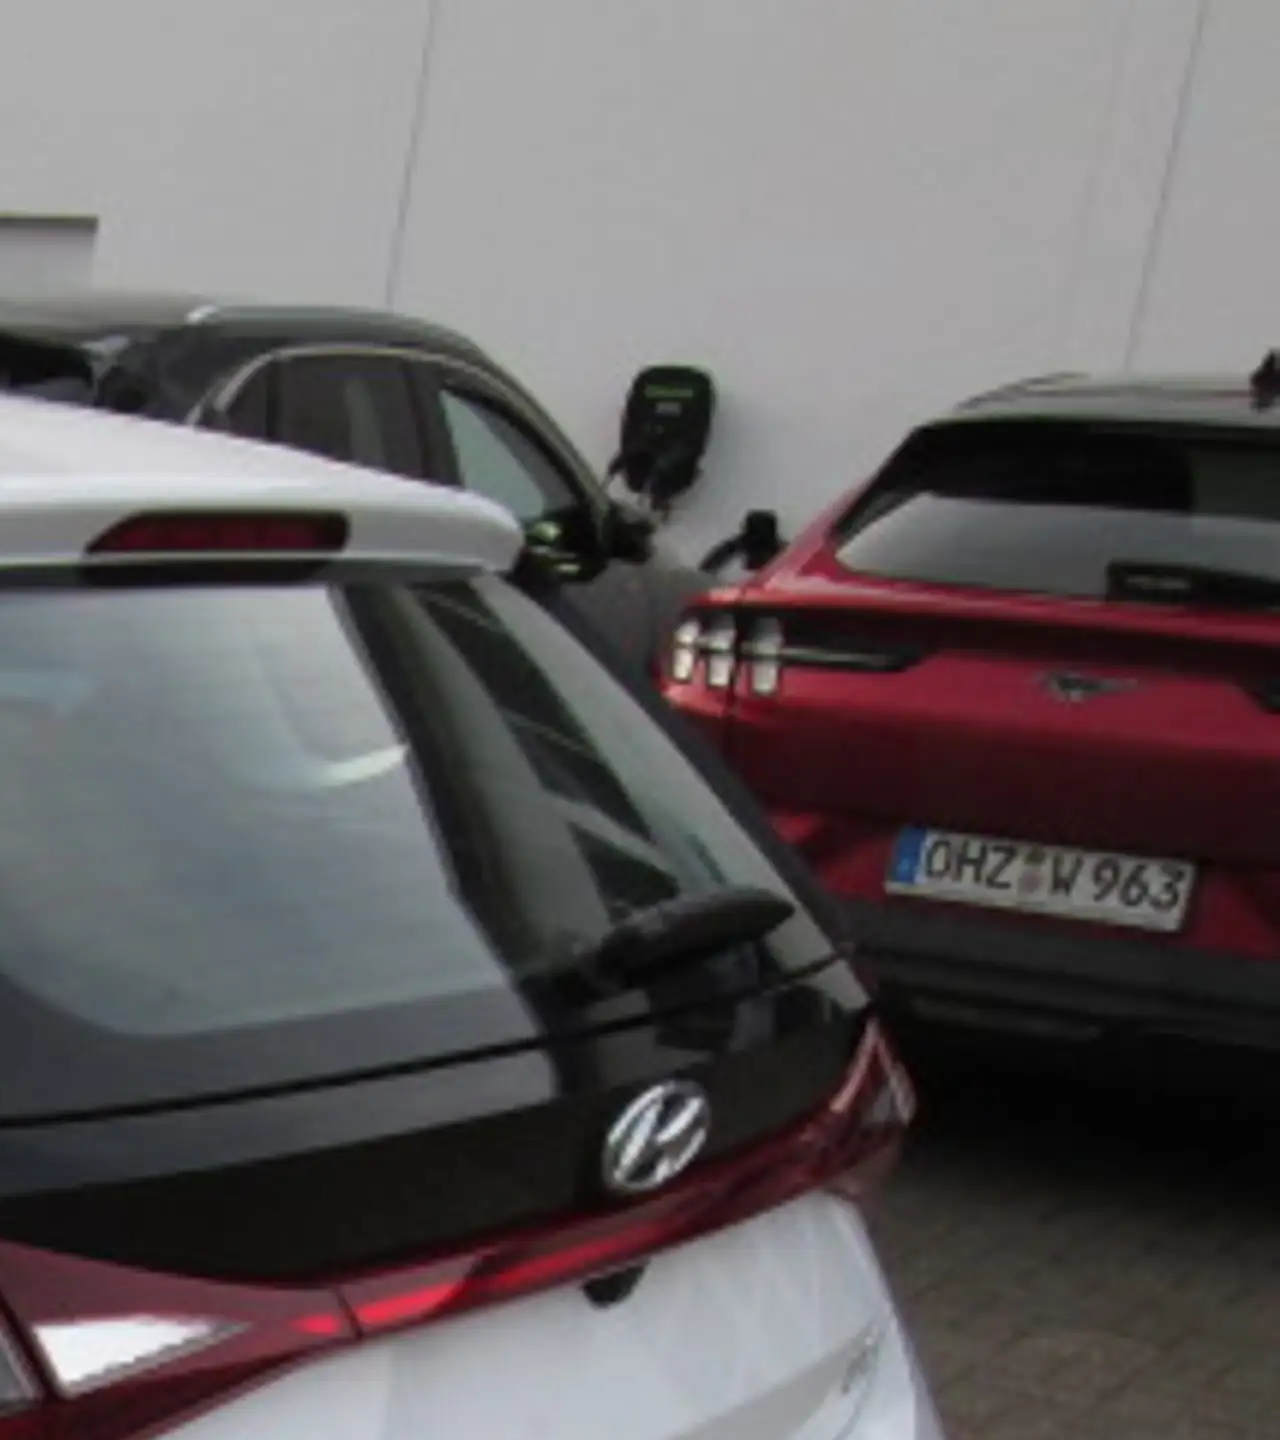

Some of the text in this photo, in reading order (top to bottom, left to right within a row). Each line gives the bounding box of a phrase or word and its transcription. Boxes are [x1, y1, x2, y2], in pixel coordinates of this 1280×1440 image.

[925, 839, 1185, 911] OHZ W 963
